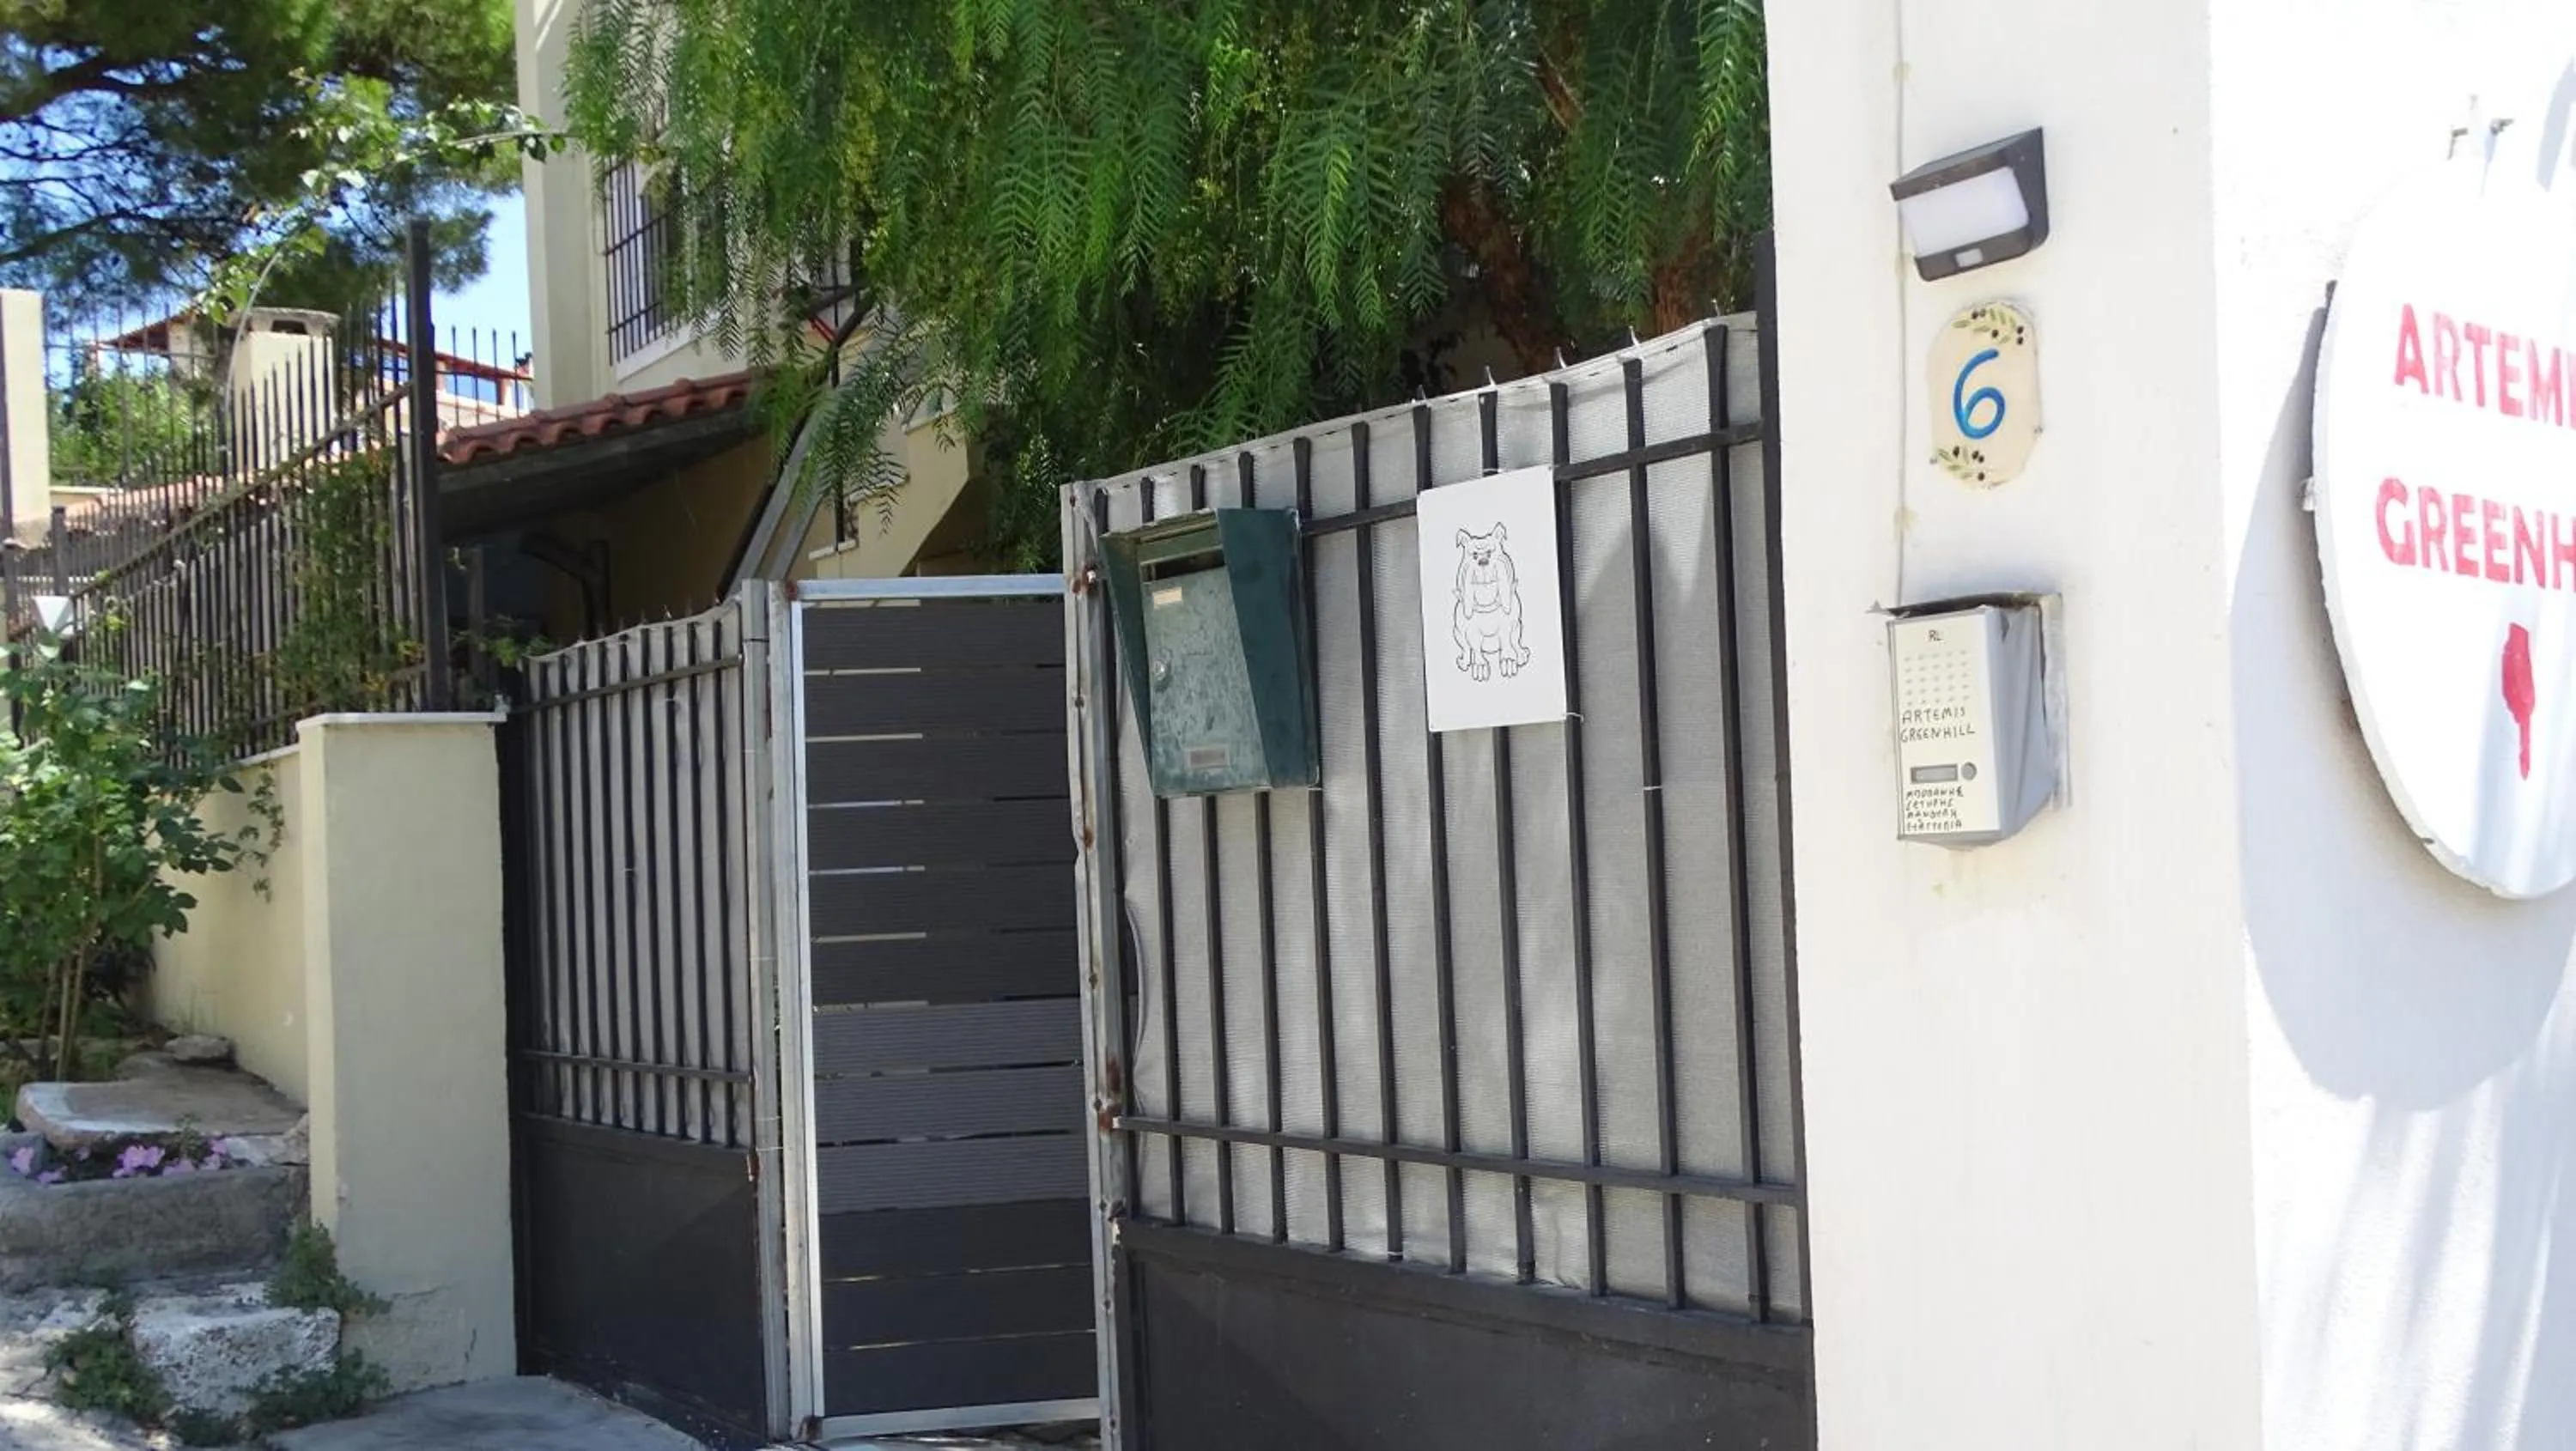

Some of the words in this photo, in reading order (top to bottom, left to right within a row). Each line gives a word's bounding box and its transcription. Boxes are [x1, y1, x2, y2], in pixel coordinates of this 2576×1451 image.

[1953, 348, 2006, 440] 6
[1901, 707, 1966, 725] ARTEMIS
[1900, 723, 1976, 743] GREENHILL
